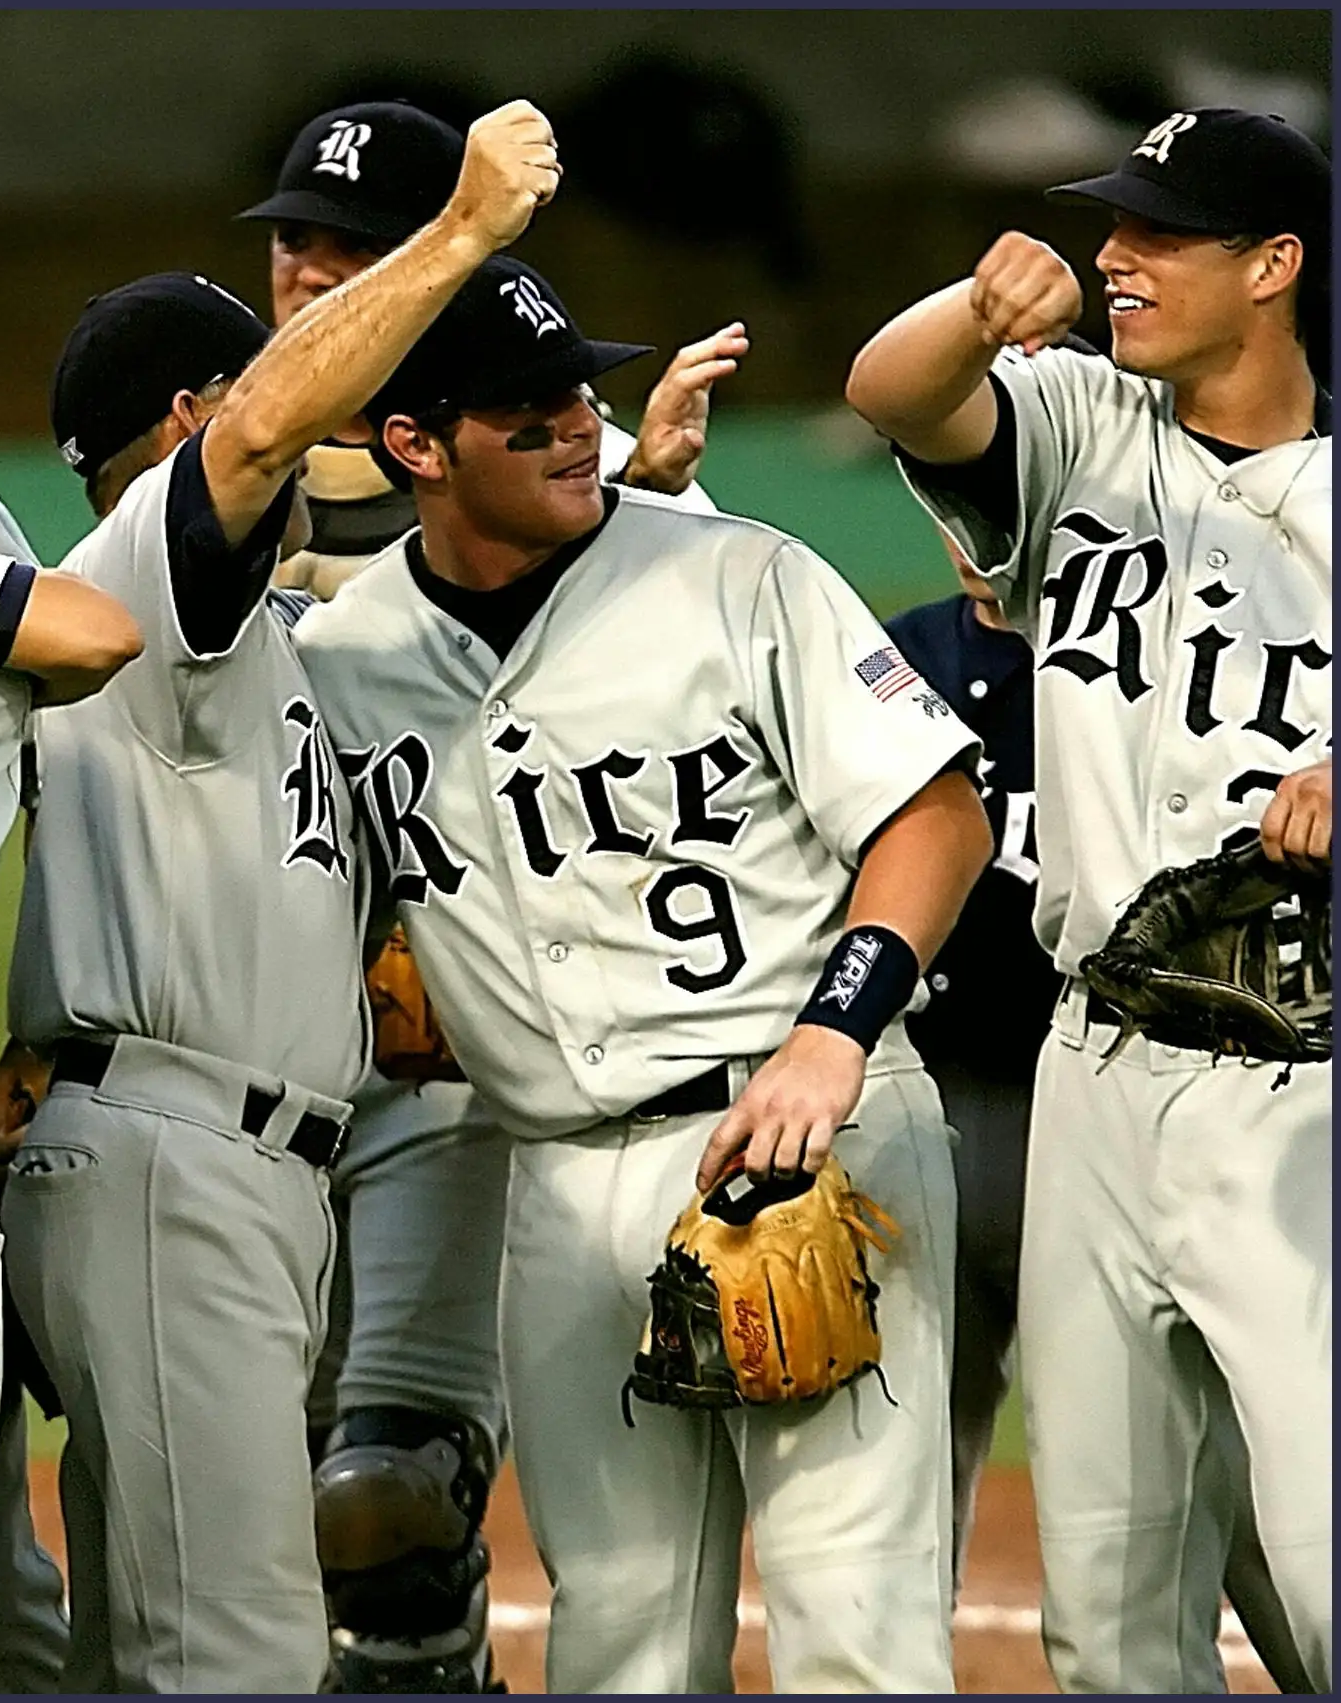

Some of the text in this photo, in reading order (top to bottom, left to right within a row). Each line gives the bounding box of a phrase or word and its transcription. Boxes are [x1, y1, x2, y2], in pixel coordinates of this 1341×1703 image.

[312, 119, 372, 182] R
[1131, 112, 1198, 164] R
[498, 274, 568, 340] R
[1038, 507, 1332, 754] Ric
[337, 725, 761, 908] Rice
[640, 862, 751, 995] 9
[819, 934, 883, 1012] TPX
